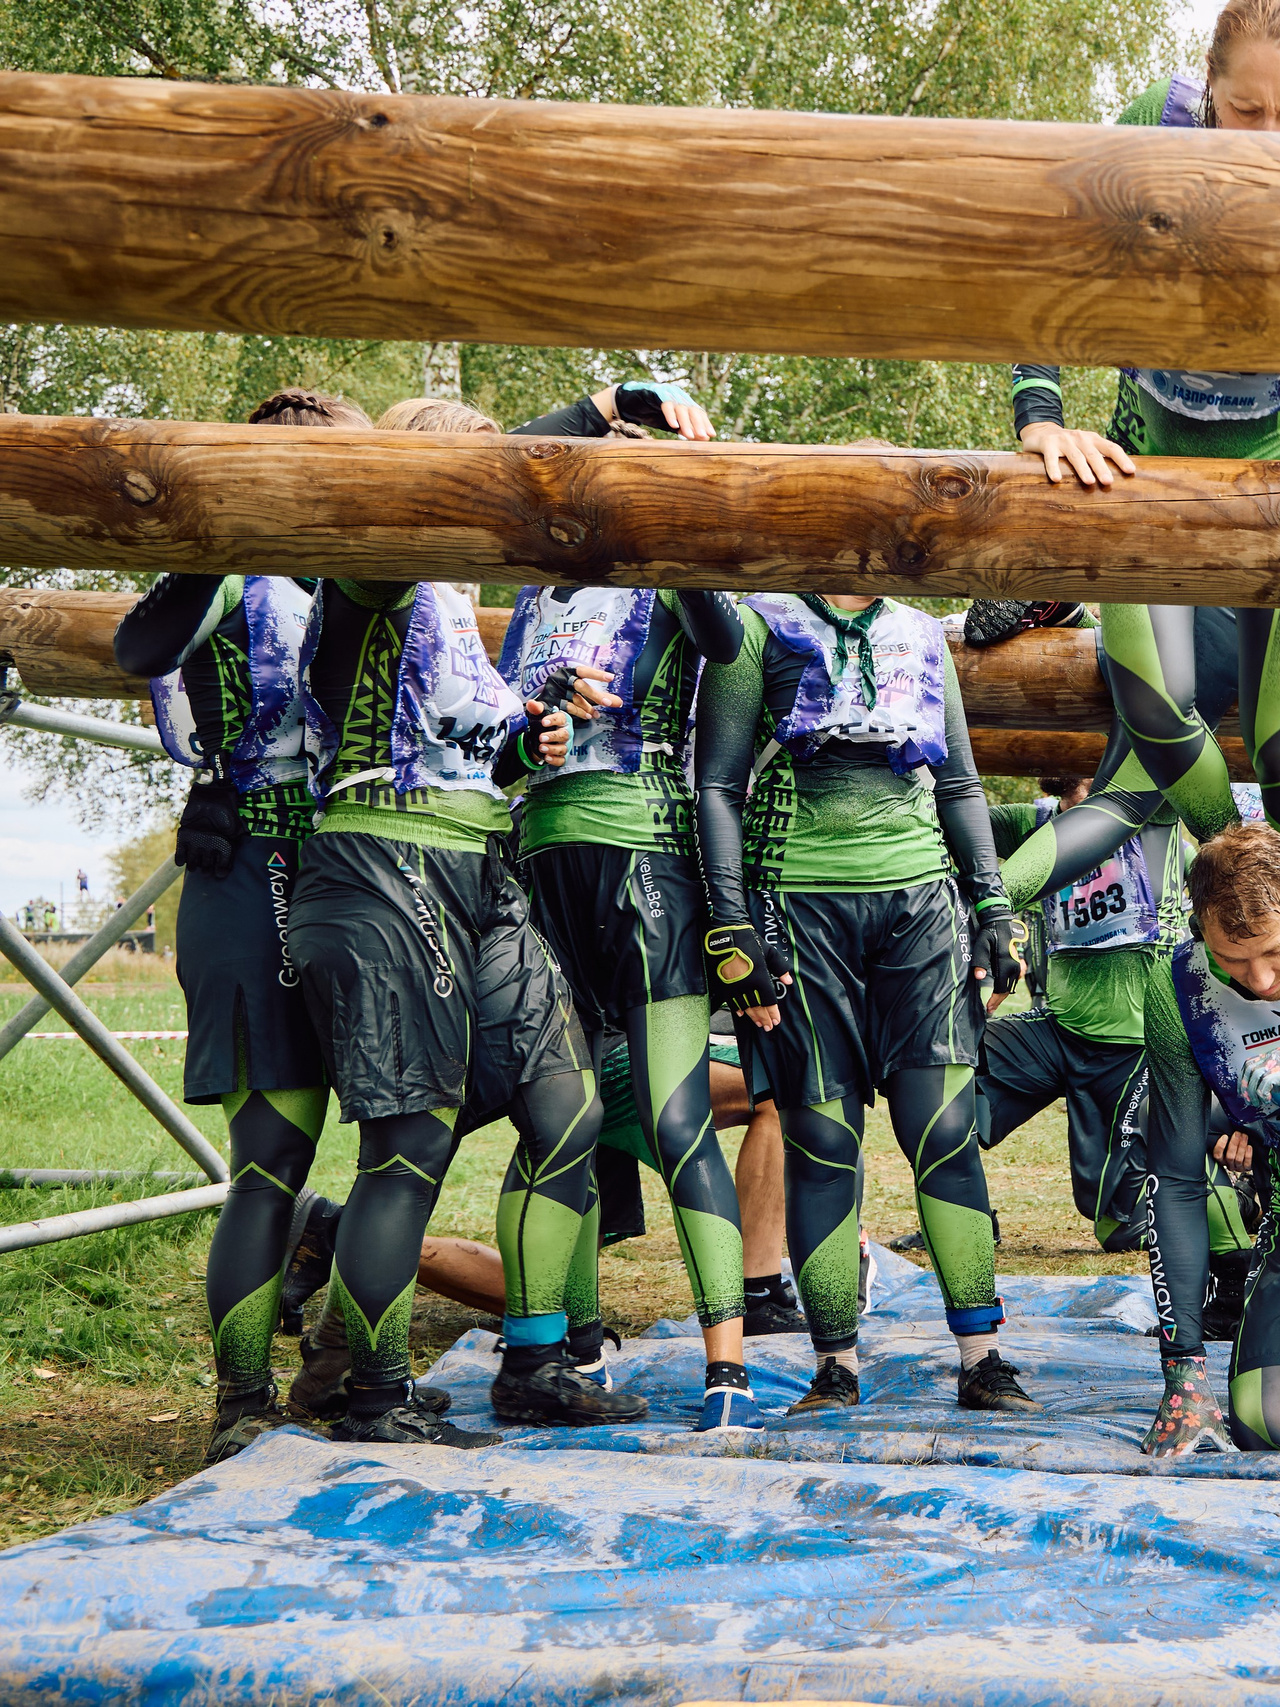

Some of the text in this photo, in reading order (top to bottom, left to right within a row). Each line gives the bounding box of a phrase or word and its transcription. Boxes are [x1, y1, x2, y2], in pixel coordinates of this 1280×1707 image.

[1172, 384, 1256, 406] ГАЗПРОМБАНК
[1060, 883, 1127, 931] 1563
[1146, 1174, 1175, 1322] Greenway
